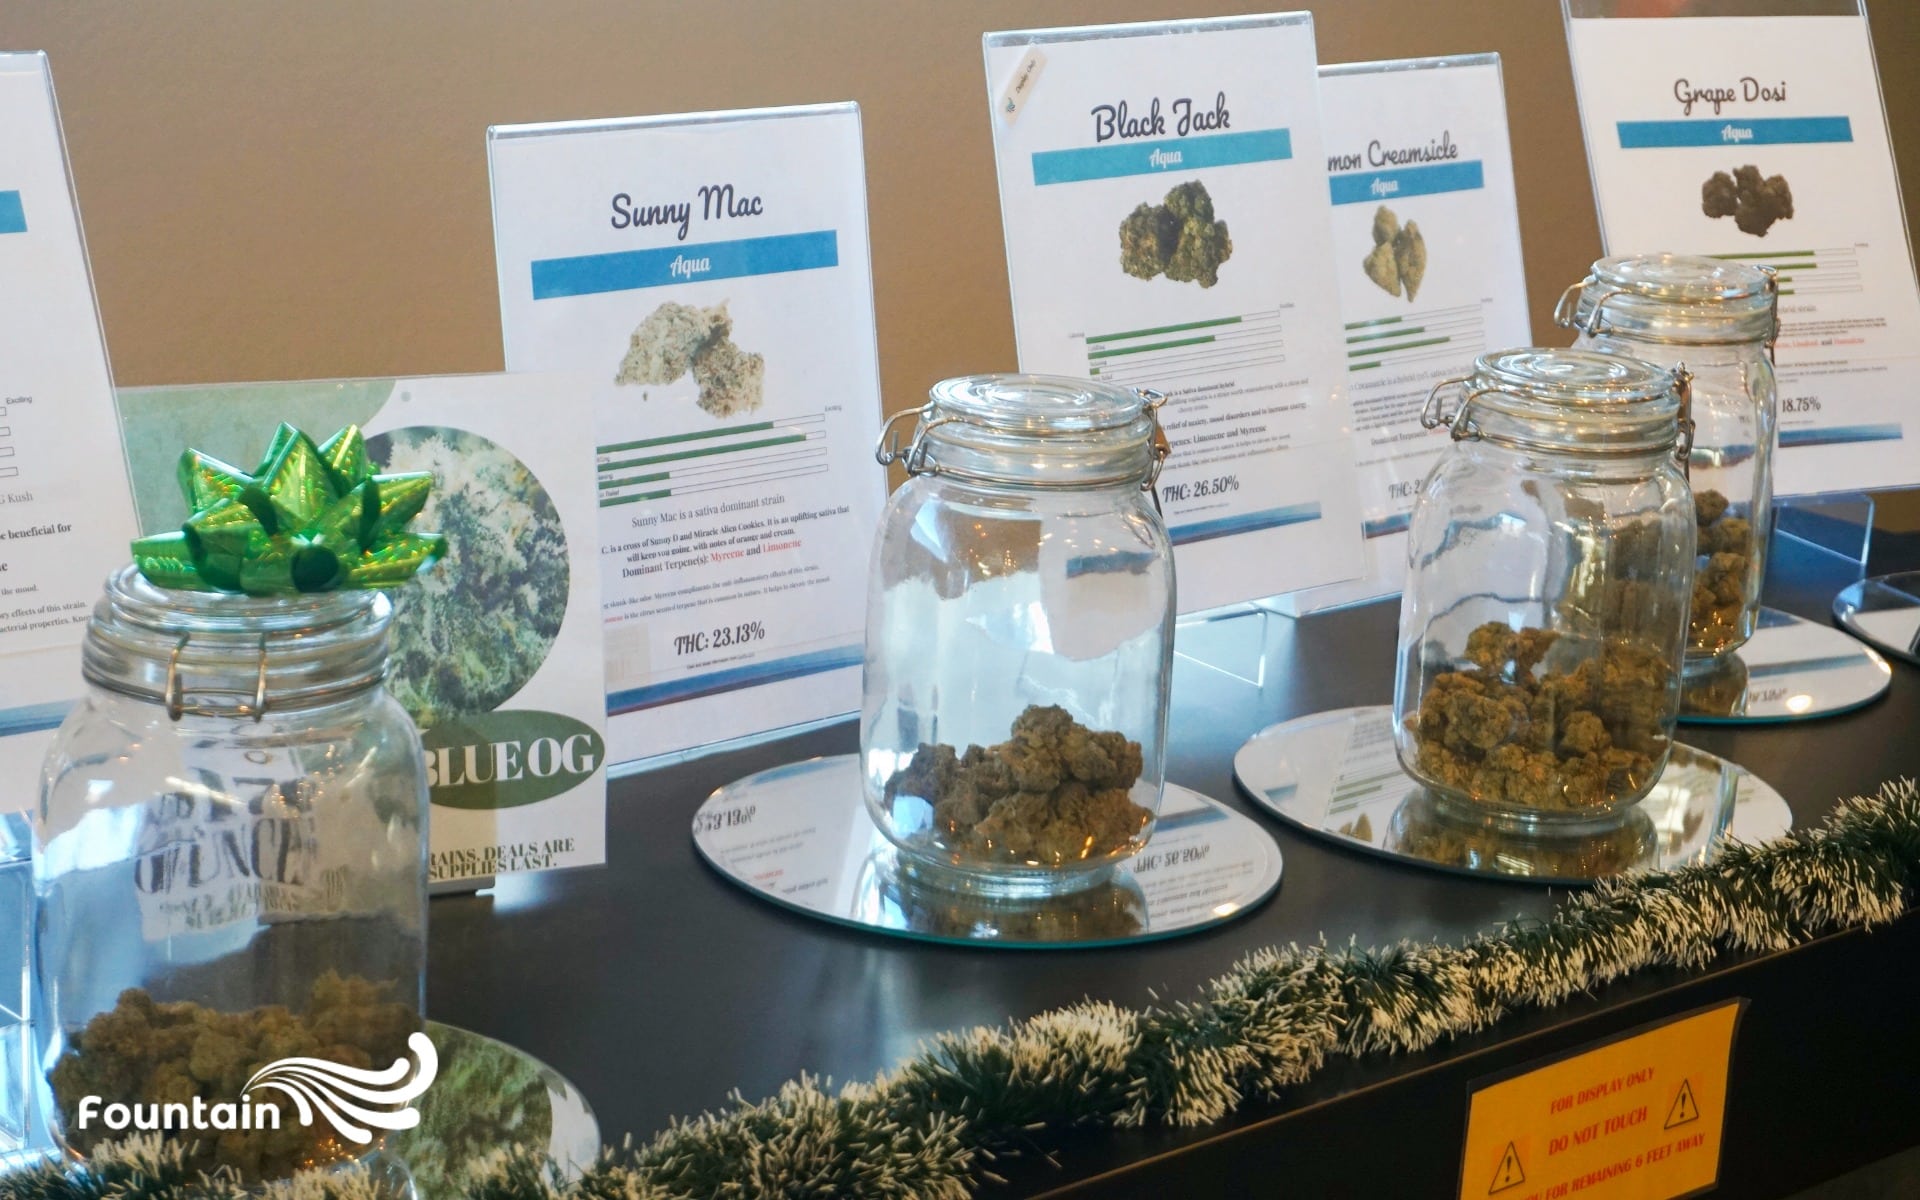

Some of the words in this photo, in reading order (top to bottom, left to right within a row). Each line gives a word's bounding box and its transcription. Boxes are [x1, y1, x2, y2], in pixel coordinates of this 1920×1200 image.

[1674, 79, 1736, 116] Grape
[1740, 76, 1787, 102] Dosi
[1091, 97, 1166, 143] Black
[1173, 91, 1231, 137] Jack
[1721, 124, 1753, 142] Aqua
[1149, 147, 1183, 168] Aqua
[1327, 151, 1362, 172] mon
[1367, 129, 1459, 168] Creamsicle
[1371, 177, 1399, 197] Aqua
[611, 193, 691, 241] Sunny
[697, 183, 764, 221] Mac
[670, 254, 712, 280] Aqua
[1781, 396, 1822, 413] 18.75%
[8, 491, 34, 504] Kush
[1162, 483, 1192, 503] THC:
[1193, 474, 1240, 498] 26.50%
[1388, 480, 1413, 500] THC:
[631, 516, 658, 528] Sunny
[660, 512, 678, 523] Mac
[679, 510, 687, 520] is
[695, 504, 719, 517] sativa
[719, 498, 759, 514] dominant
[761, 494, 785, 507] strain
[8, 524, 56, 540] beneficial
[57, 523, 73, 534] for
[610, 544, 617, 553] is
[623, 542, 641, 551] cross
[641, 538, 649, 548] of
[679, 531, 693, 541] and
[693, 526, 719, 539] Miracle
[720, 524, 737, 536] Alien
[773, 516, 780, 525] is
[818, 507, 837, 518] sativa
[837, 504, 850, 515] that
[693, 540, 708, 551] with
[709, 538, 727, 549] notes
[728, 535, 736, 545] of
[760, 530, 773, 540] and
[622, 561, 663, 578] Dominant
[710, 549, 745, 563] Myrcene
[746, 543, 761, 556] and
[762, 540, 802, 553] Limonene
[0, 623, 28, 633] acterial
[673, 632, 709, 656] THC:
[712, 620, 766, 649] 23.13%
[527, 733, 595, 778] OG
[430, 848, 480, 866] RAINS.
[484, 841, 538, 861] DEALS
[542, 837, 576, 854] ARE
[428, 858, 507, 881] SUPPLIES
[511, 853, 558, 873] LAST.
[1550, 1093, 1574, 1115] FOR
[1577, 1076, 1626, 1106] DISPLAY
[1627, 1066, 1656, 1087] ONLY
[1548, 1134, 1569, 1156] DO
[1572, 1122, 1600, 1147] NOT
[1604, 1105, 1649, 1136] TOUCH
[1571, 1160, 1632, 1192] REMAINING
[1635, 1156, 1643, 1169] 6
[1646, 1144, 1672, 1166] FEET
[1675, 1133, 1706, 1155] AWAY
